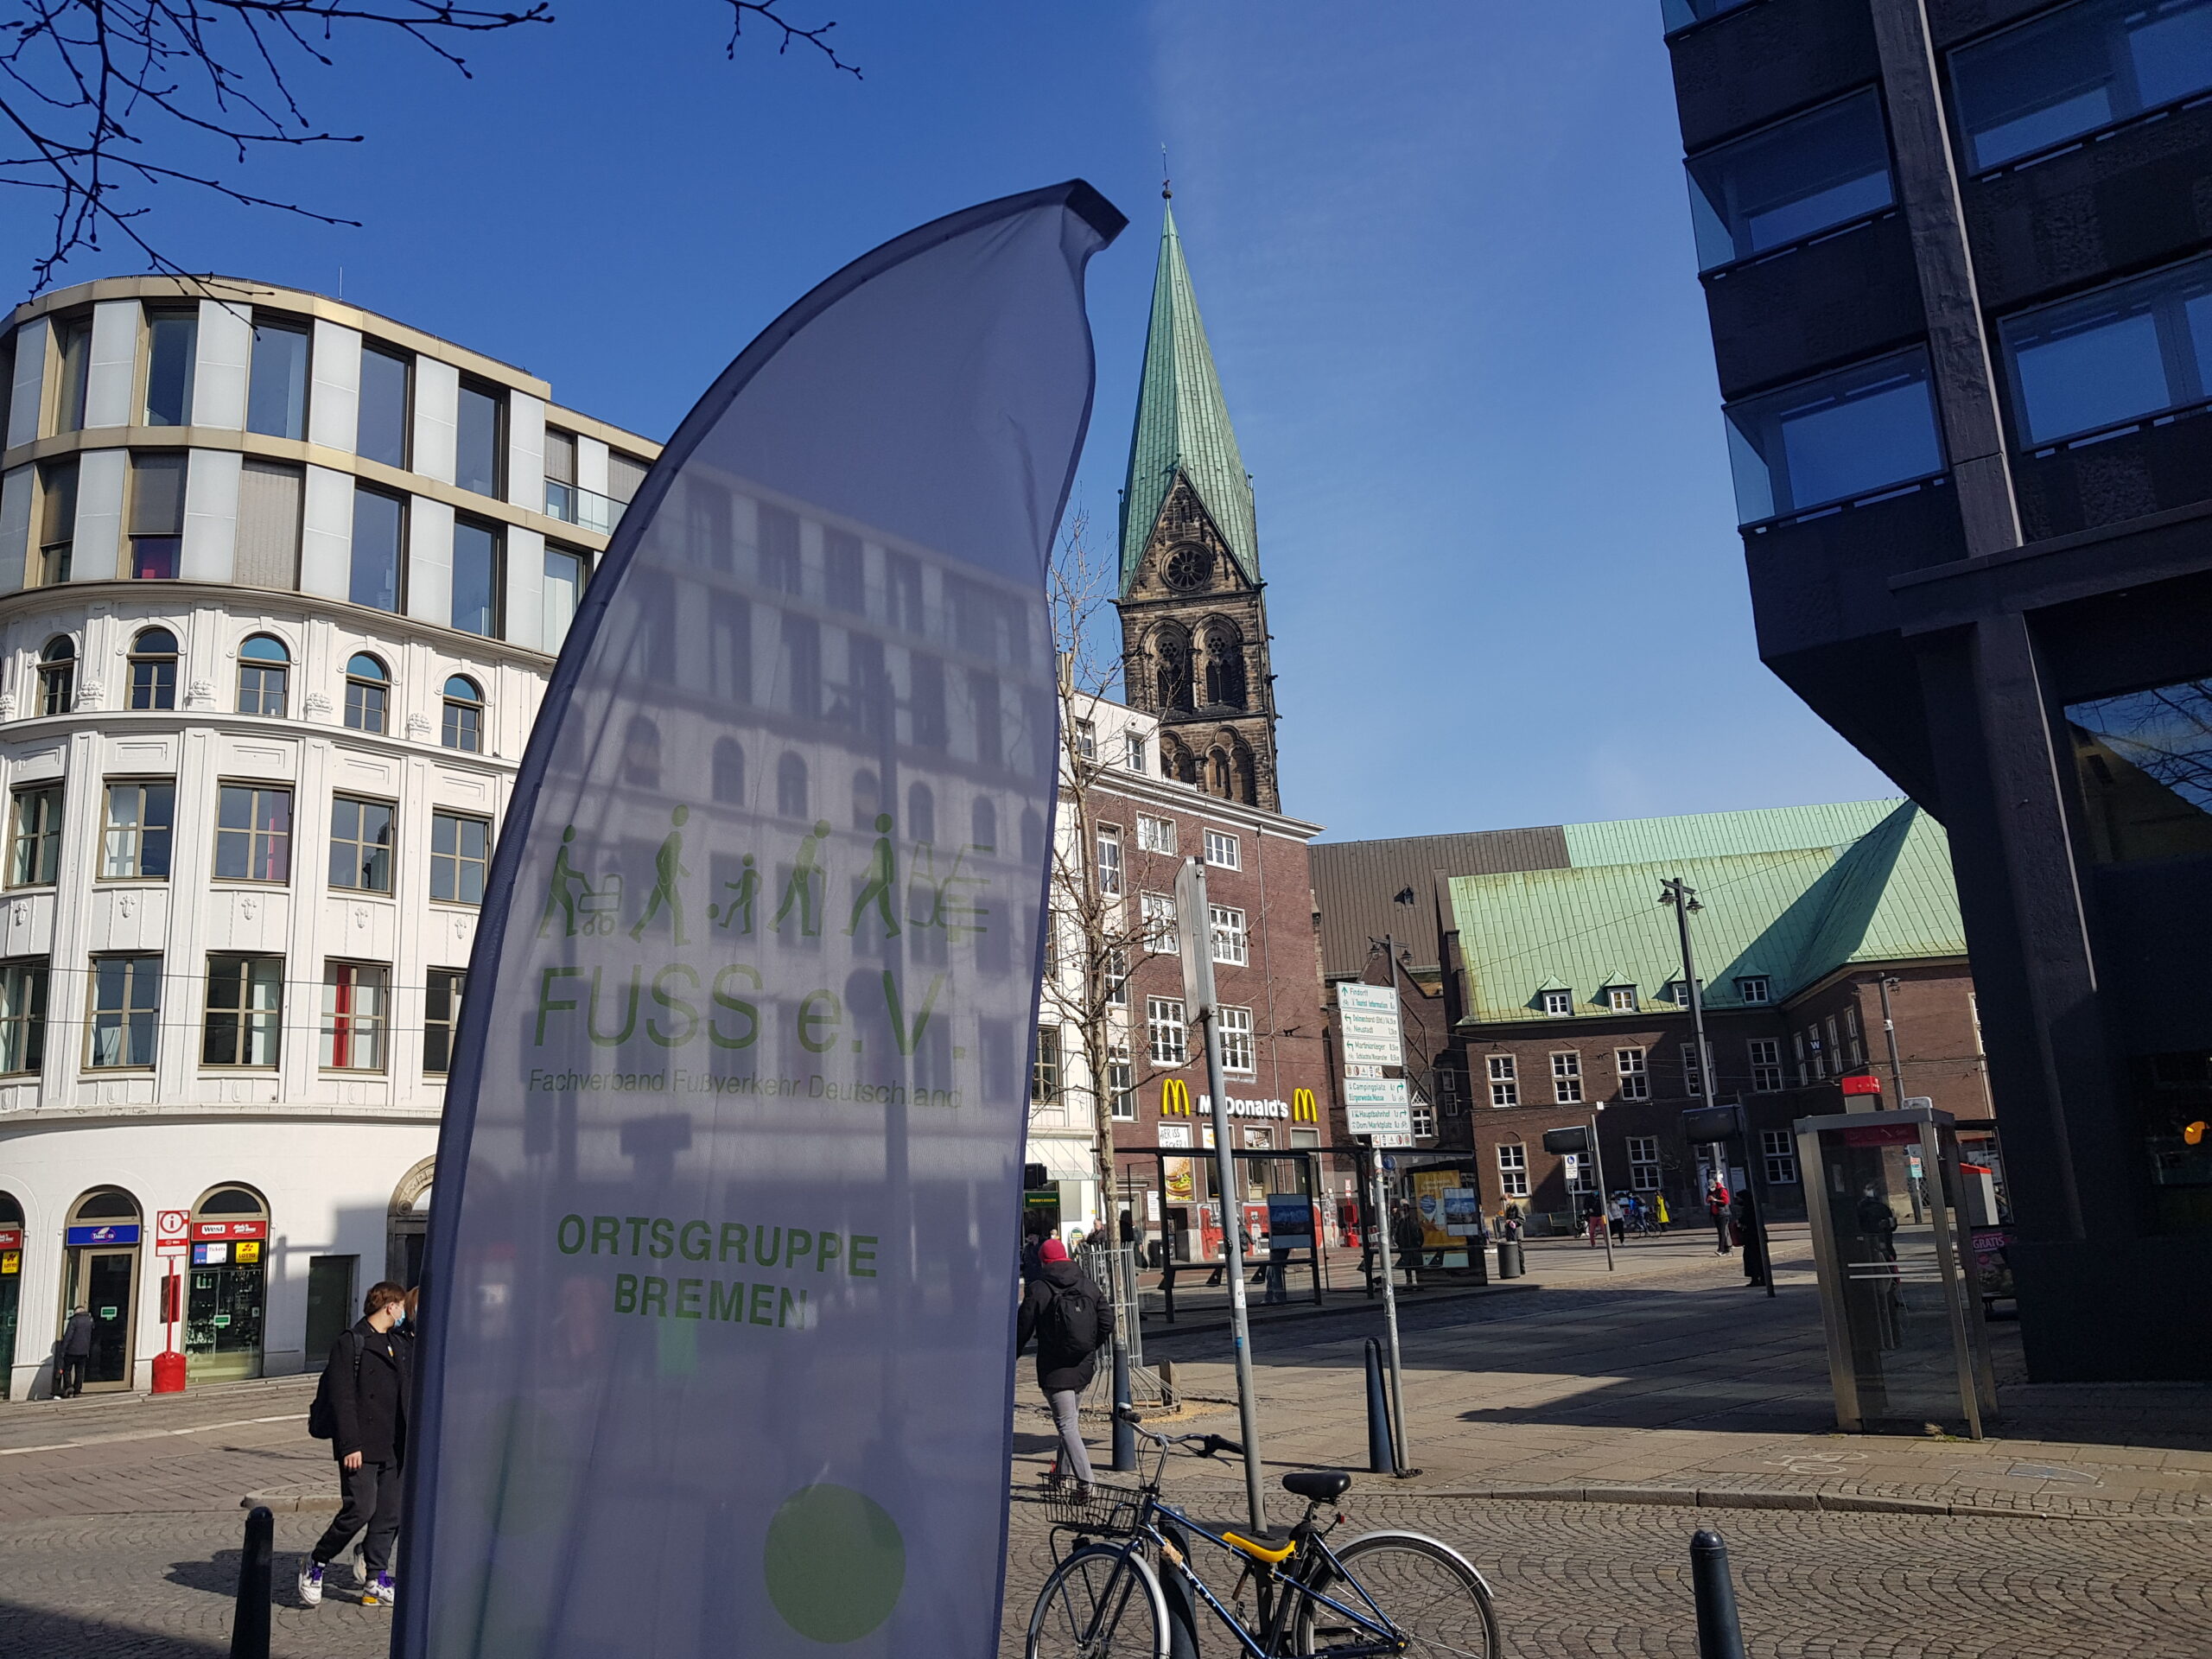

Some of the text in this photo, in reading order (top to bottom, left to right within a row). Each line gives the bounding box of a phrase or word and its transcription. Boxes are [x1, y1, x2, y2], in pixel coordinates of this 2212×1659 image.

[1350, 988, 1368, 997] Findorff
[534, 963, 764, 1049] FUSS
[1354, 1025, 1374, 1033] Neustadt
[530, 1068, 963, 1109] Fachverband Fußverkehr Deutschland
[1353, 1082, 1386, 1092] Campingplatz
[1199, 1095, 1289, 1118] MDonald's
[1359, 1110, 1390, 1119] Hauptbahnhof
[557, 1214, 878, 1278] ORTSGRUPPE
[1973, 1236, 2005, 1249] GRATIS
[614, 1274, 807, 1330] BREMEN
